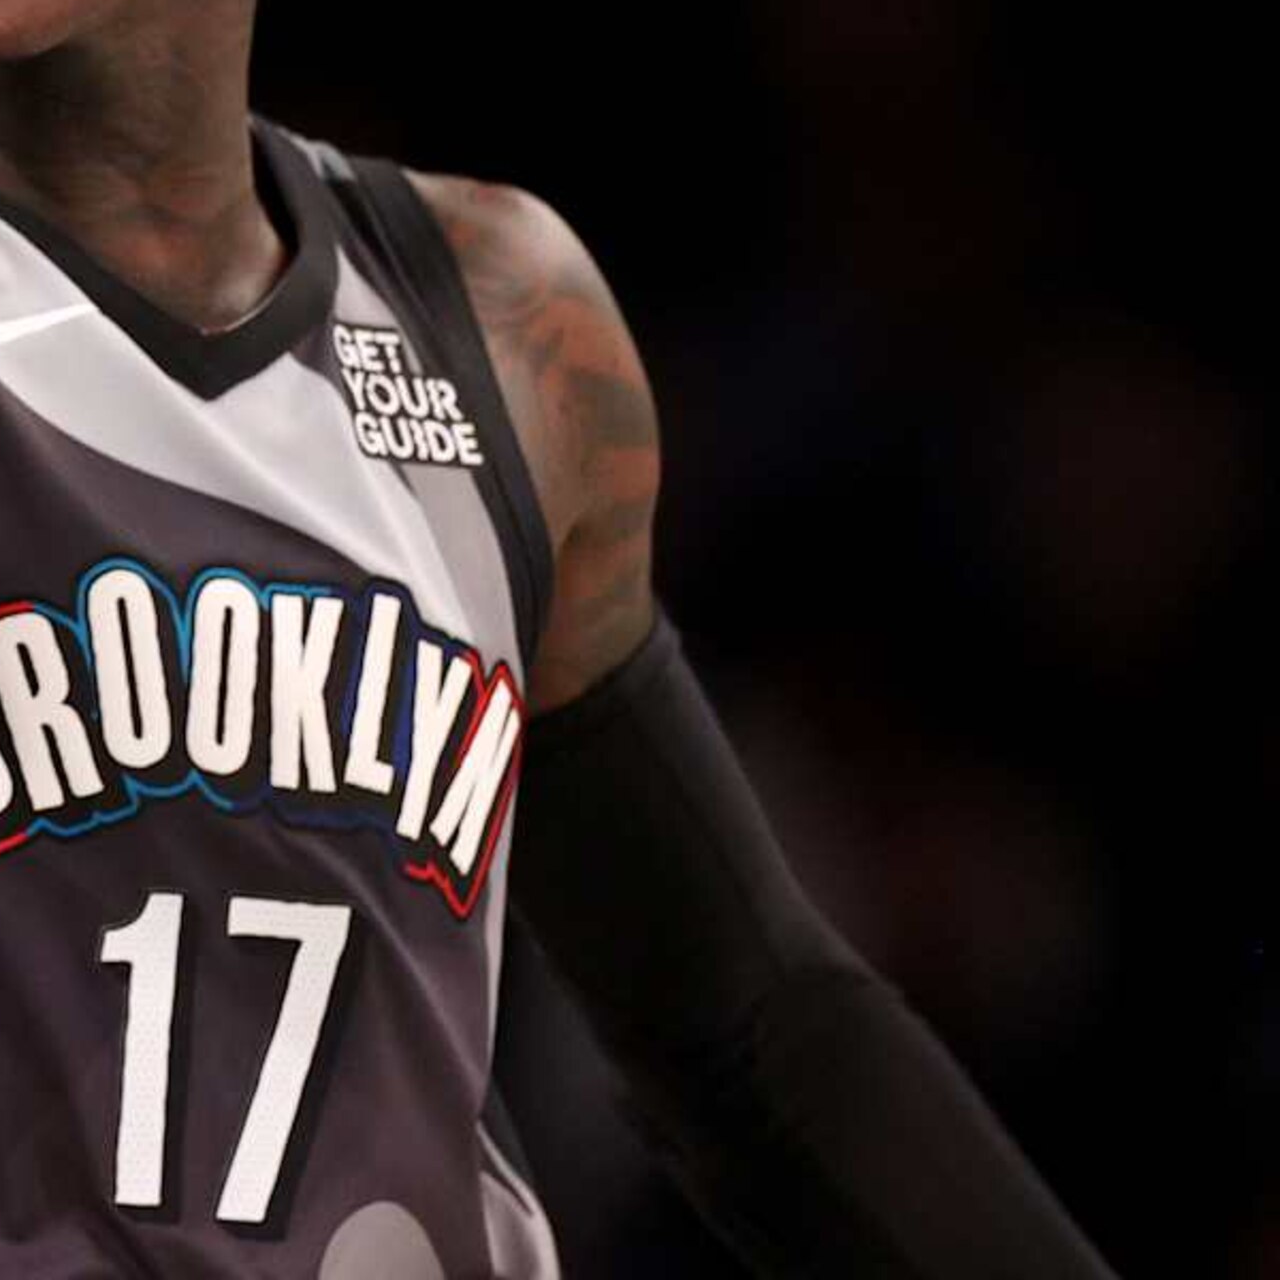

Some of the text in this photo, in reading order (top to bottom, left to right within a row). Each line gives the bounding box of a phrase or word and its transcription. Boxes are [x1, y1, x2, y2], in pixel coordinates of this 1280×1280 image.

[333, 324, 400, 373] GET
[341, 367, 463, 421] YOUR
[355, 411, 484, 465] GUIDE
[101, 892, 351, 1223] 17
